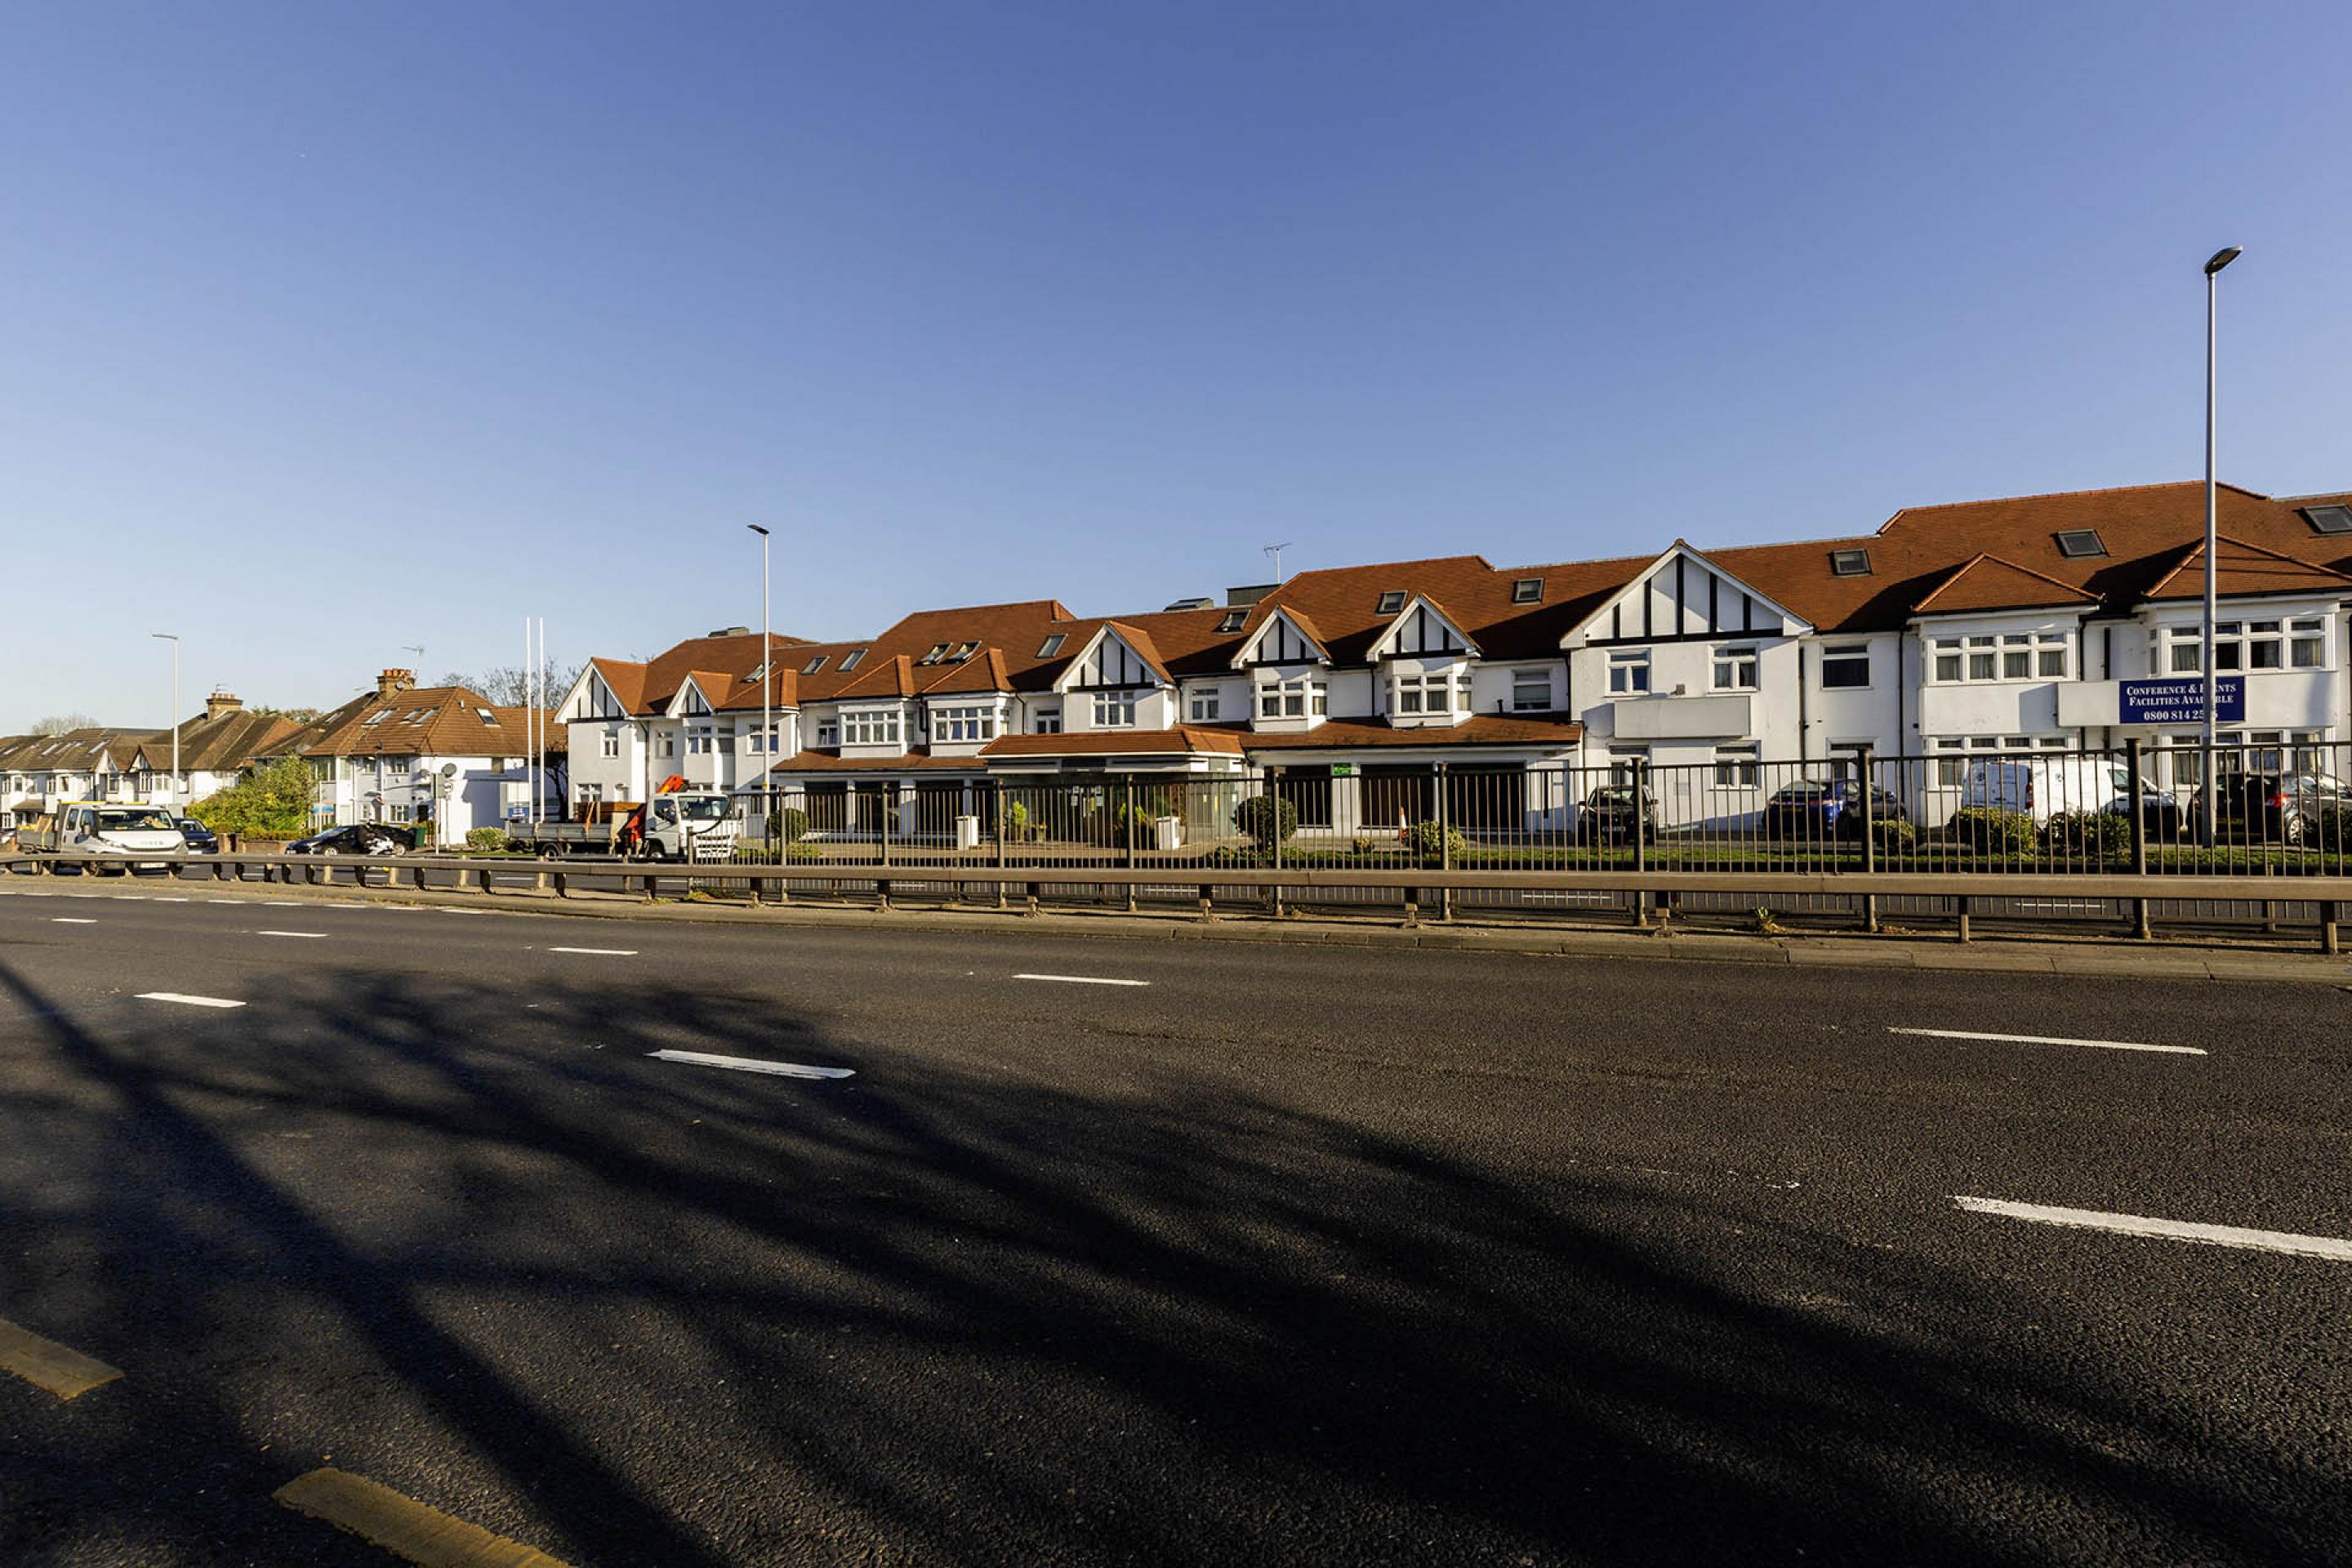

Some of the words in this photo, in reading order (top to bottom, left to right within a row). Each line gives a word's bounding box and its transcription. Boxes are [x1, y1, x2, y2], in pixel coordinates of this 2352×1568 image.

[2126, 685, 2186, 696] CONFERENCE
[2188, 684, 2197, 694] &
[2129, 697, 2180, 706] FACILITIES
[2143, 710, 2169, 721] 0800
[2171, 710, 2189, 720] 814
